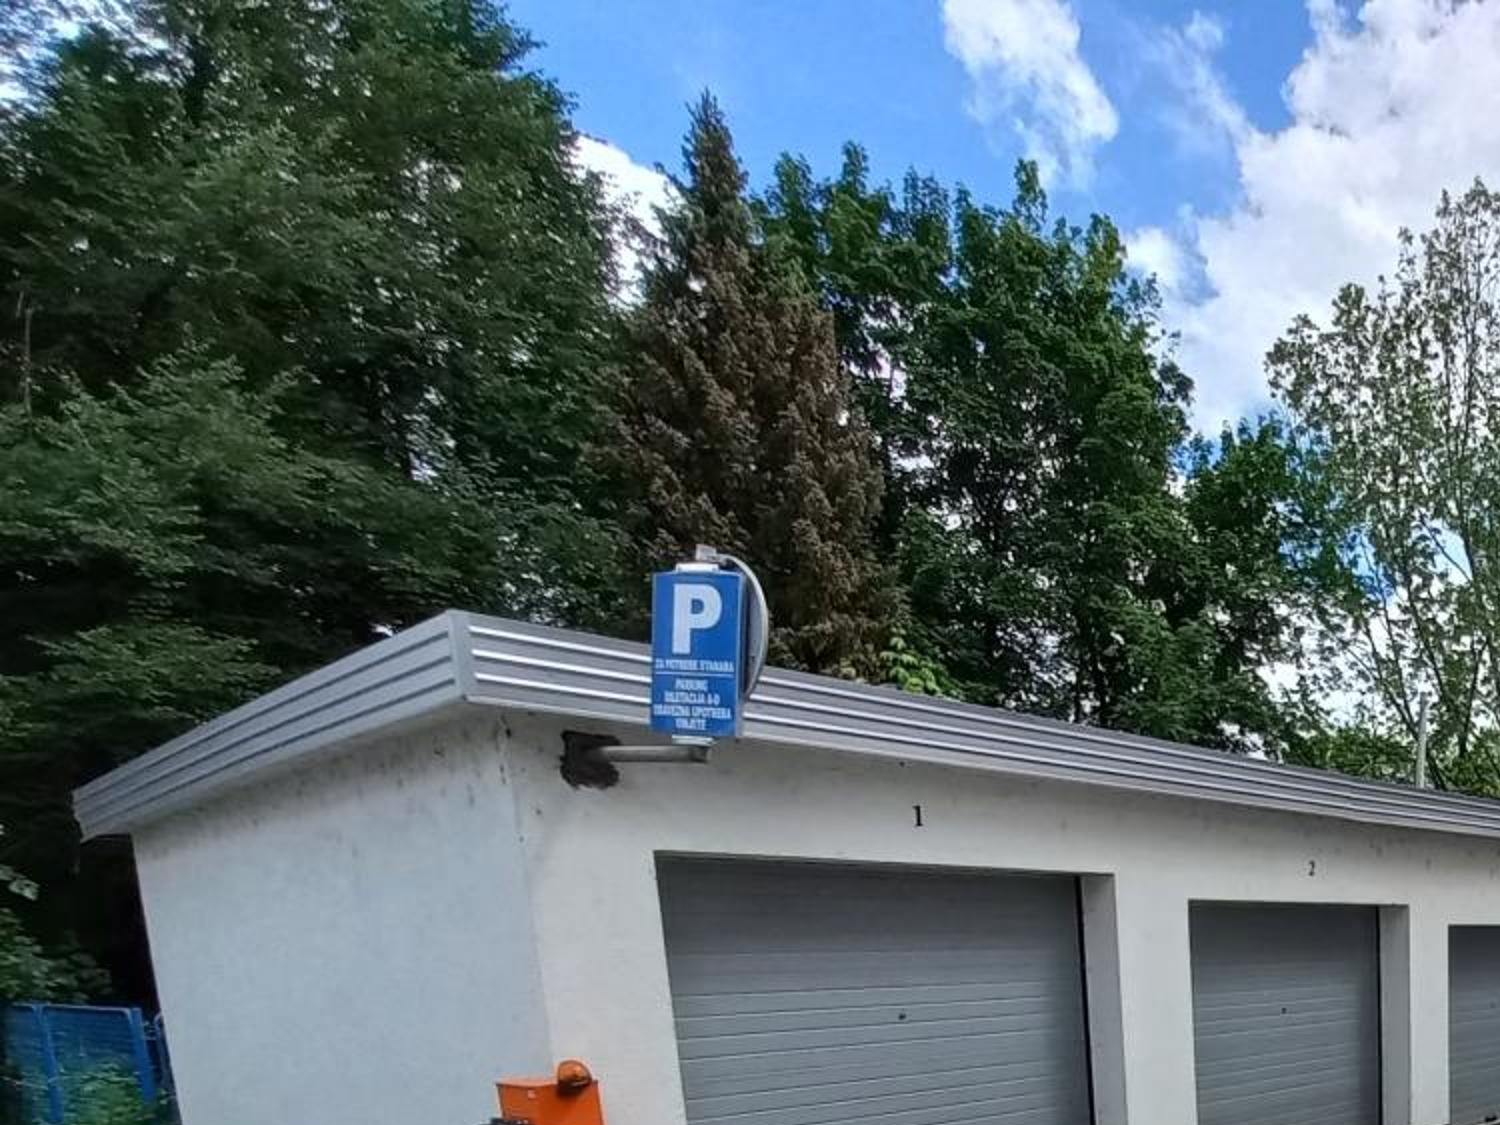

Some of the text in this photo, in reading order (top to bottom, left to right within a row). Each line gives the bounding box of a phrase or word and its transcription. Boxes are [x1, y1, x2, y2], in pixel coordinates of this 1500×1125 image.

[672, 583, 722, 655] P
[912, 805, 923, 826] 1
[1308, 860, 1316, 876] 2
